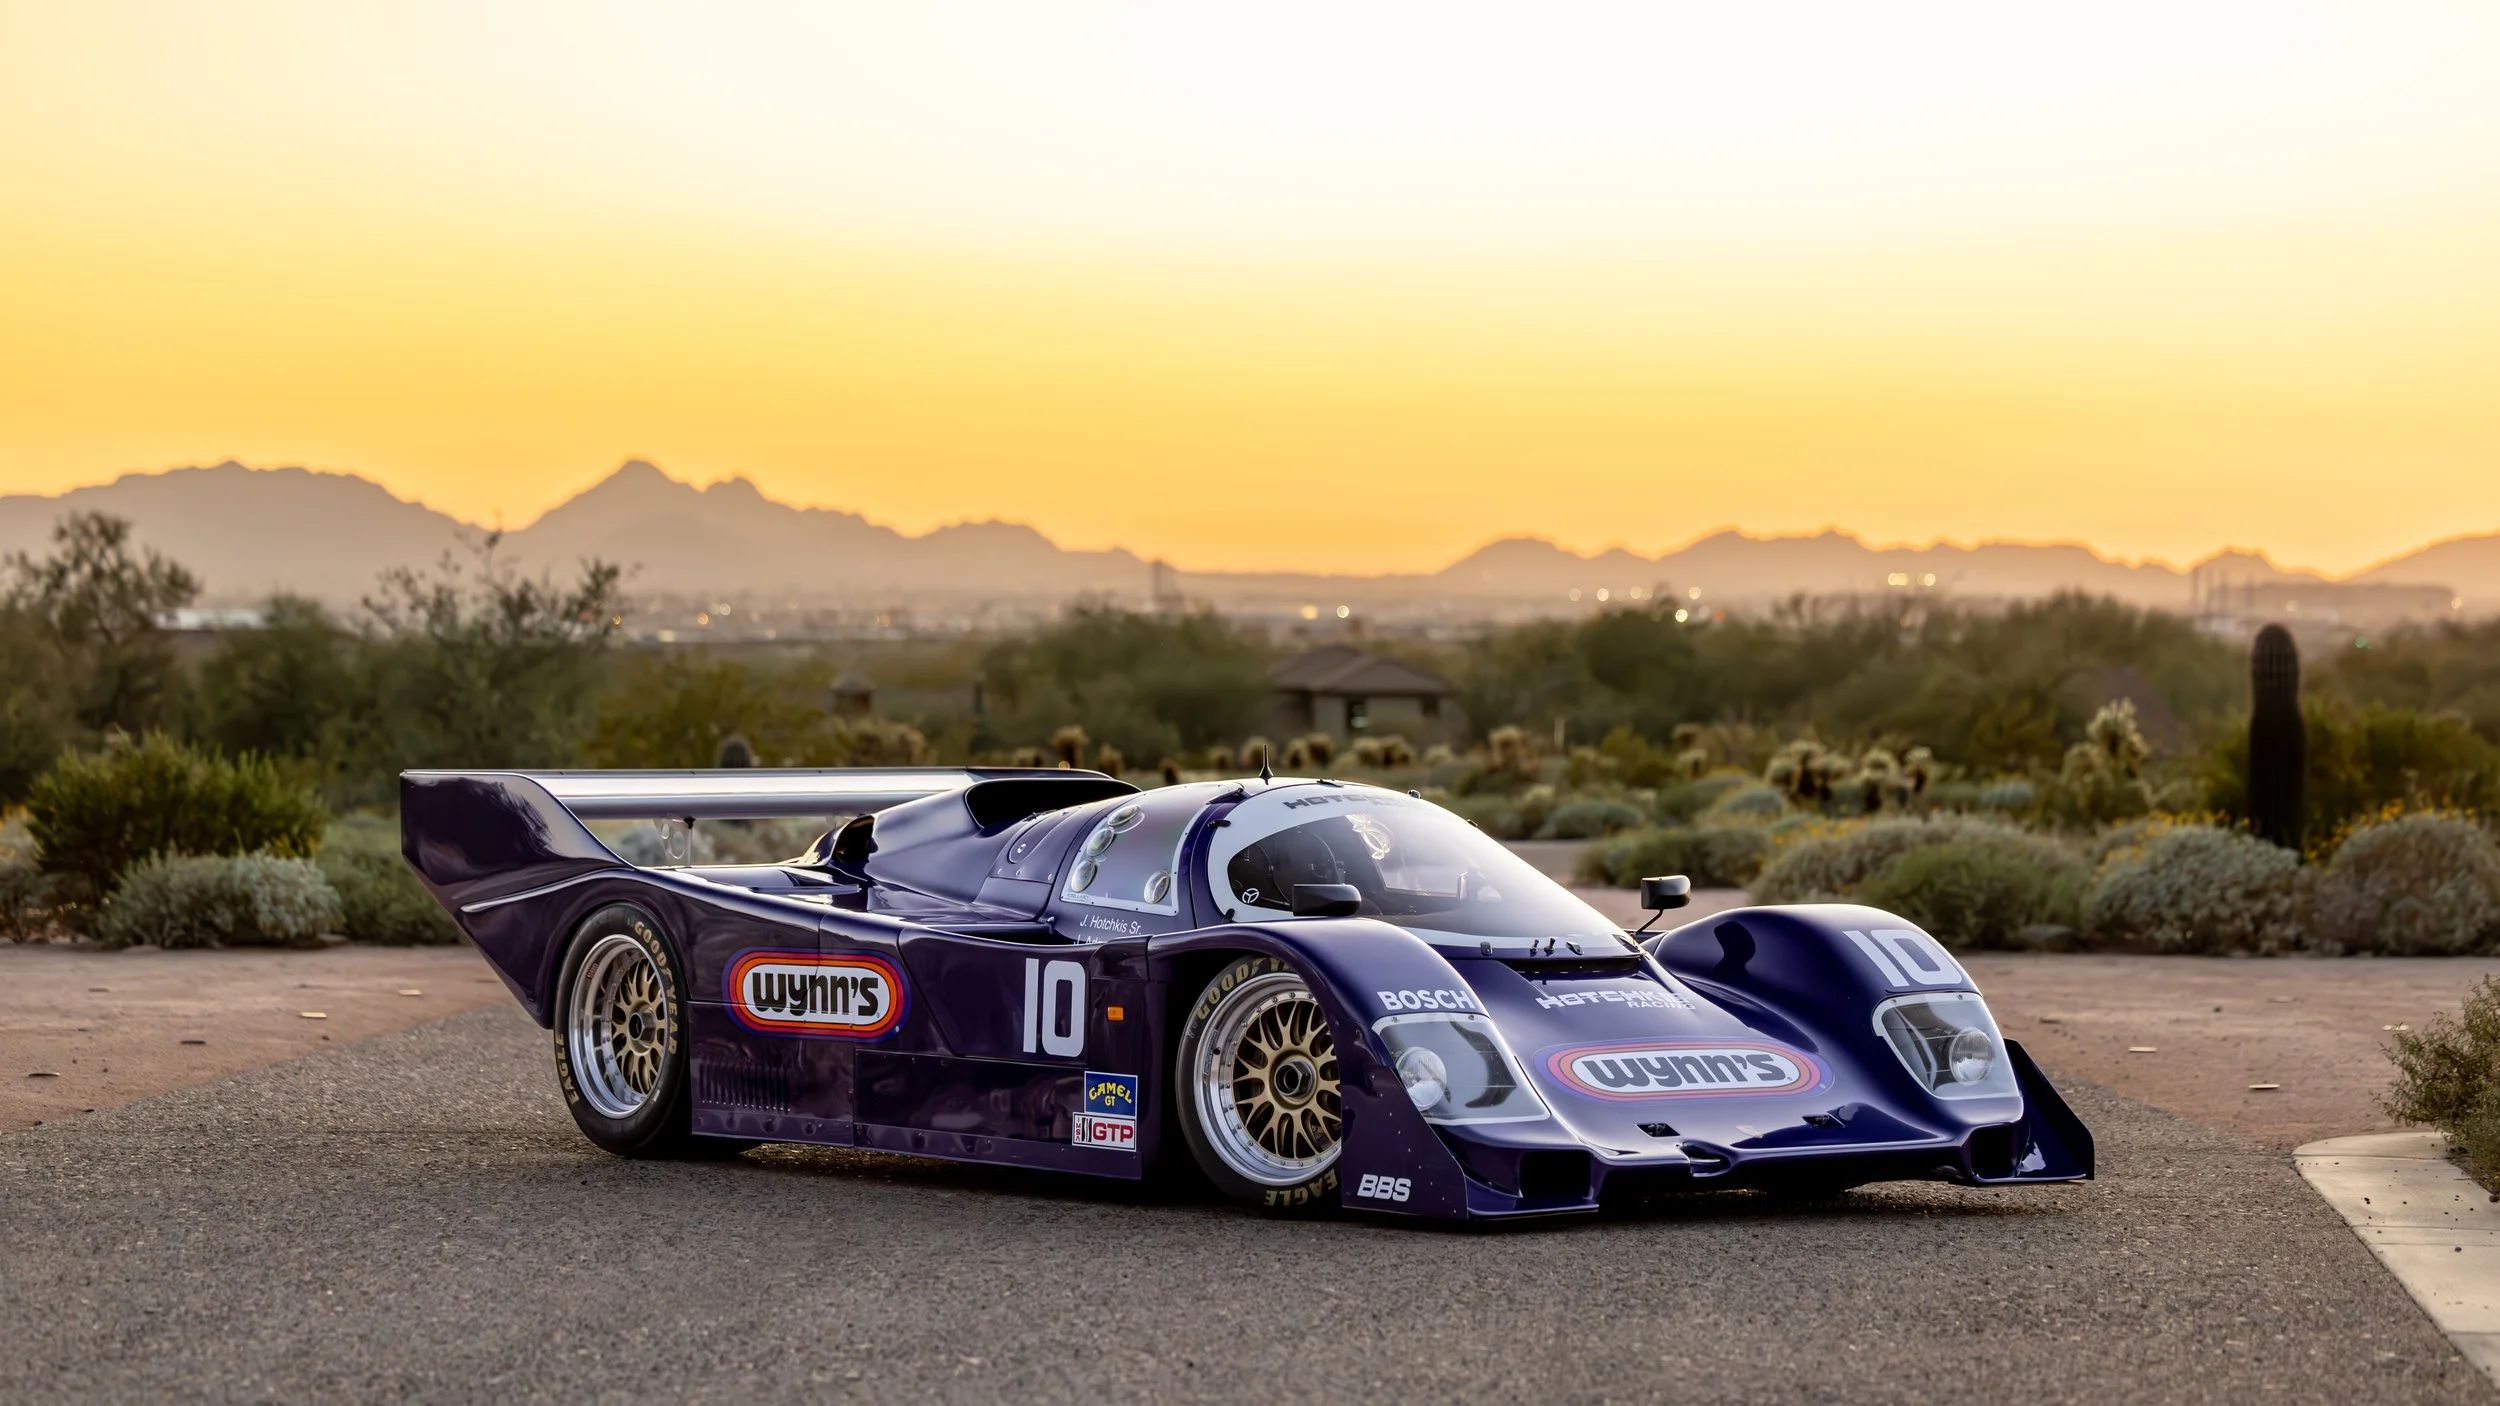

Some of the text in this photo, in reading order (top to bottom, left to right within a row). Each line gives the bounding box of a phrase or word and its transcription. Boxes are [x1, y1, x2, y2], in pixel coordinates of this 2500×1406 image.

[1080, 914, 1142, 935] J. Hotchkis Sr.
[1841, 929, 1963, 987] 10
[1023, 957, 1086, 1058] 10
[1376, 989, 1476, 1010] BOSCH
[556, 1032, 580, 1105] EAGLE
[1088, 1082, 1133, 1104] CAMEL
[1104, 1095, 1116, 1107] GT
[1092, 1122, 1134, 1143] GTP
[1263, 1168, 1338, 1207] EAGLE
[1356, 1173, 1412, 1203] BBS
